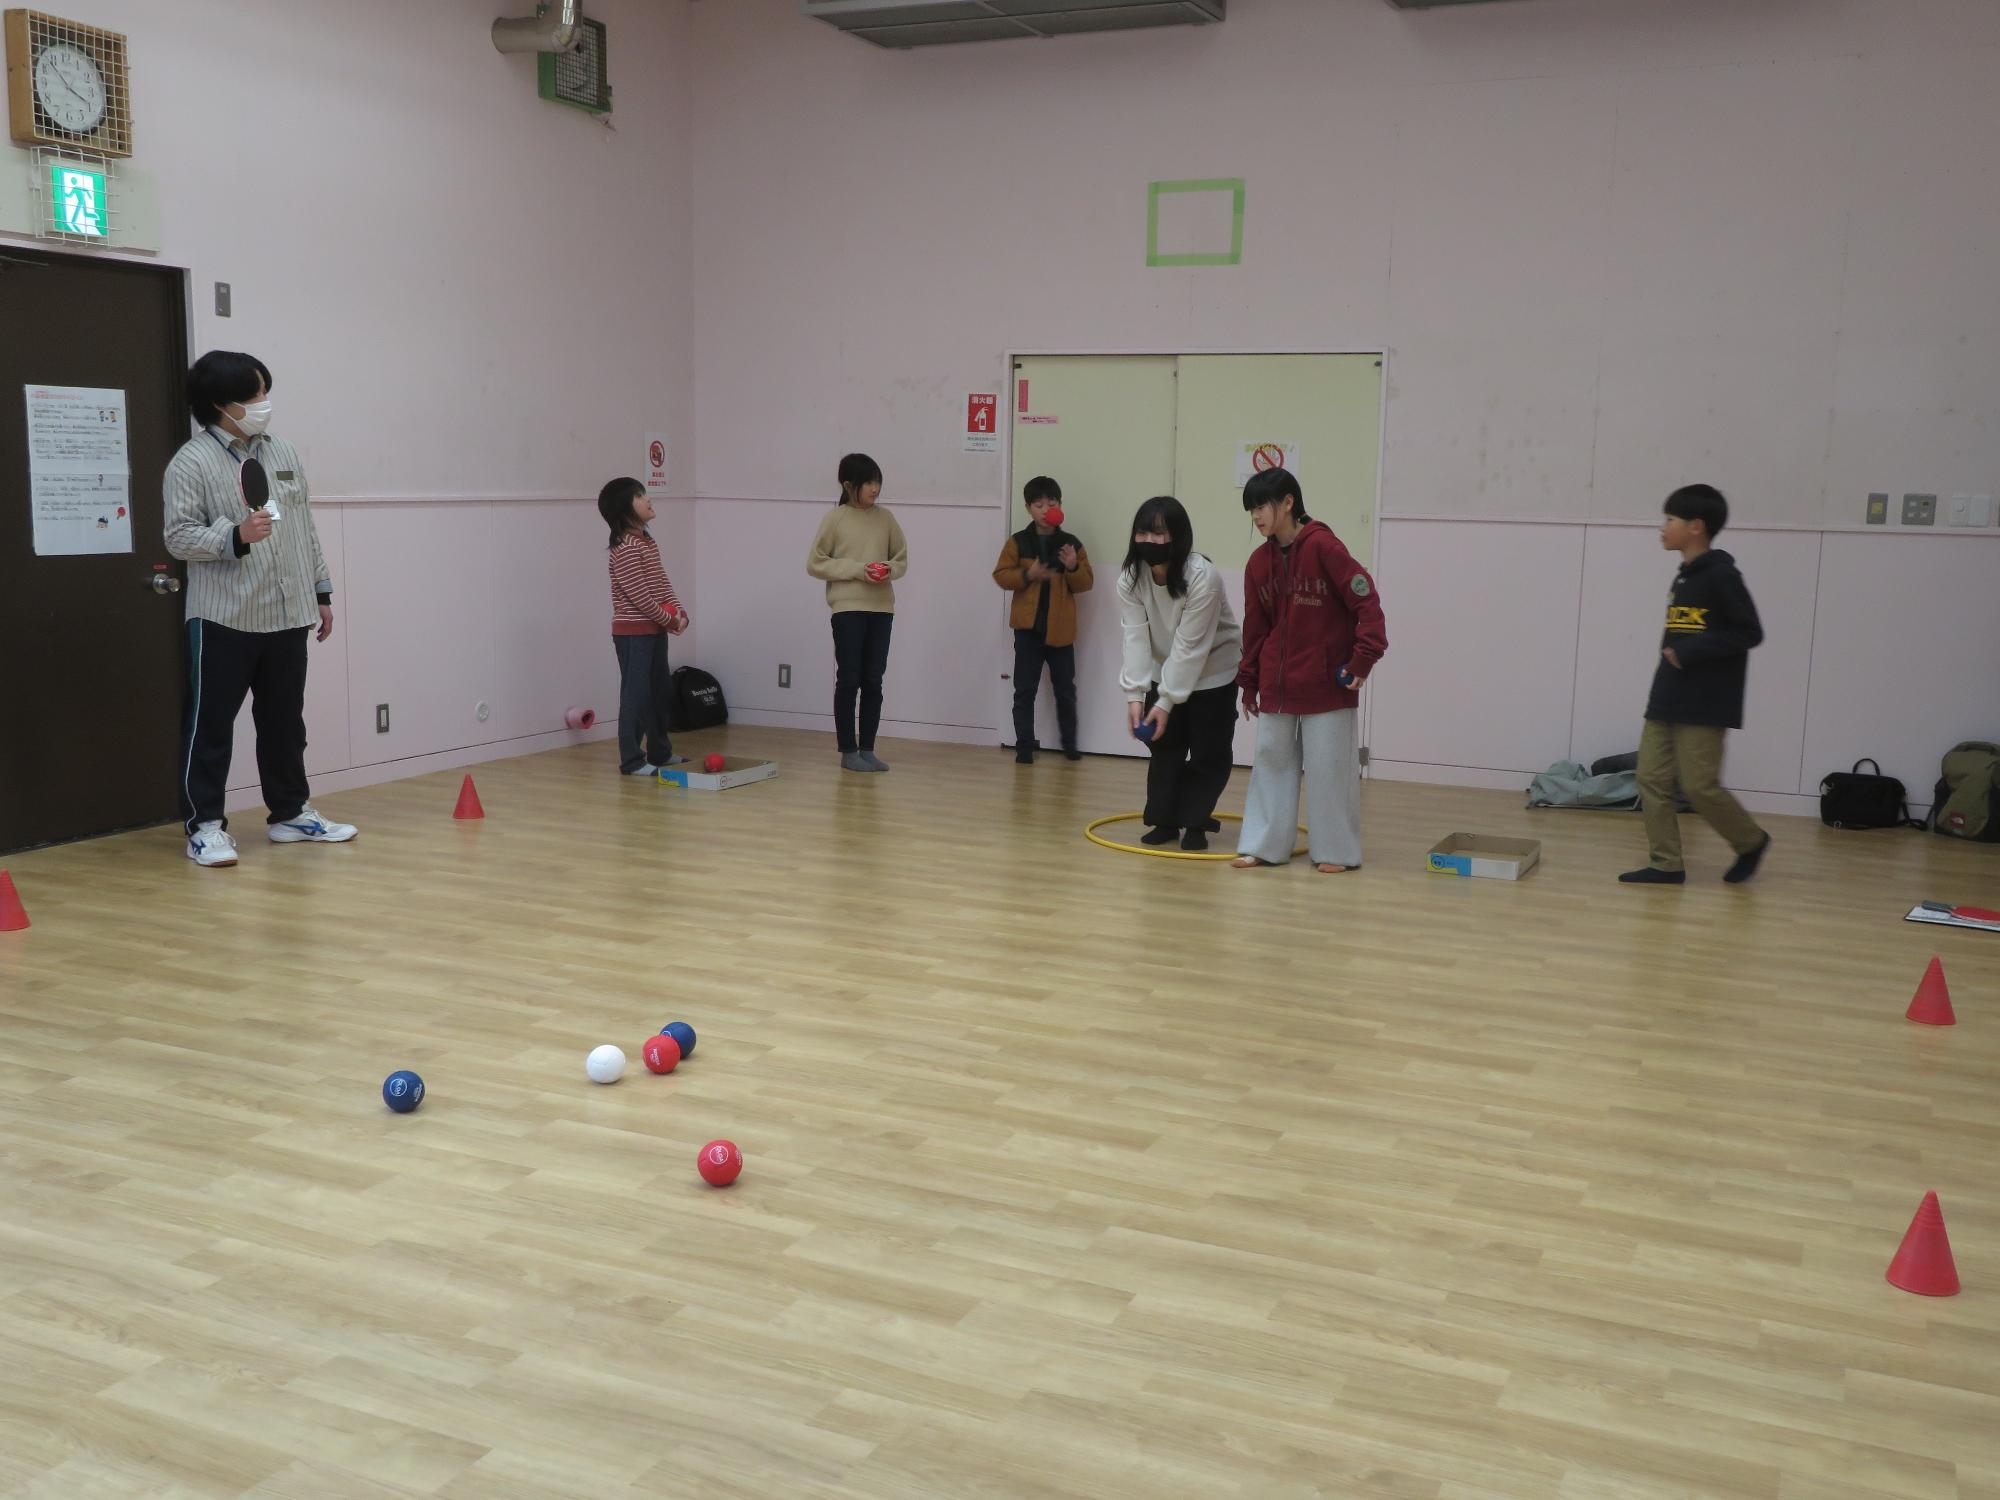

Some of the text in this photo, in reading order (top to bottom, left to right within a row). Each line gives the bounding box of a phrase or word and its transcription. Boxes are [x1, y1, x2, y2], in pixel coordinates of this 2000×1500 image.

[61, 53, 71, 64] 12
[84, 71, 91, 83] 2
[44, 91, 51, 104] 8
[87, 86, 95, 98] 3
[66, 111, 73, 121] 6
[78, 109, 85, 121] 5
[972, 396, 994, 405] 消火器
